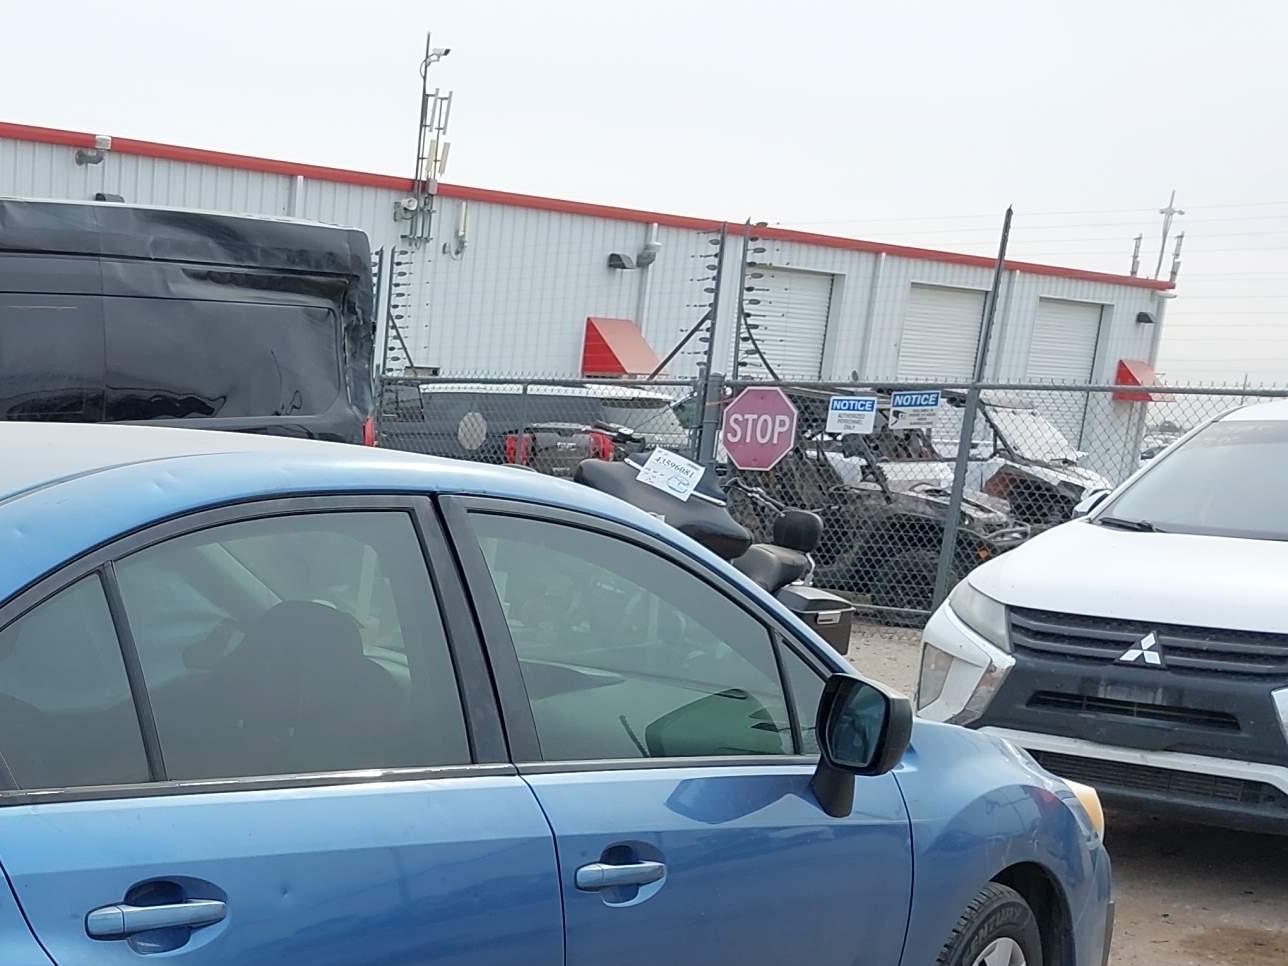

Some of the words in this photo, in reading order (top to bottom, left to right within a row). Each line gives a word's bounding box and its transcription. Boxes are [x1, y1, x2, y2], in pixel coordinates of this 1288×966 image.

[832, 400, 873, 411] NOTICE
[893, 393, 938, 406] NOTICE
[727, 413, 790, 444] STOP
